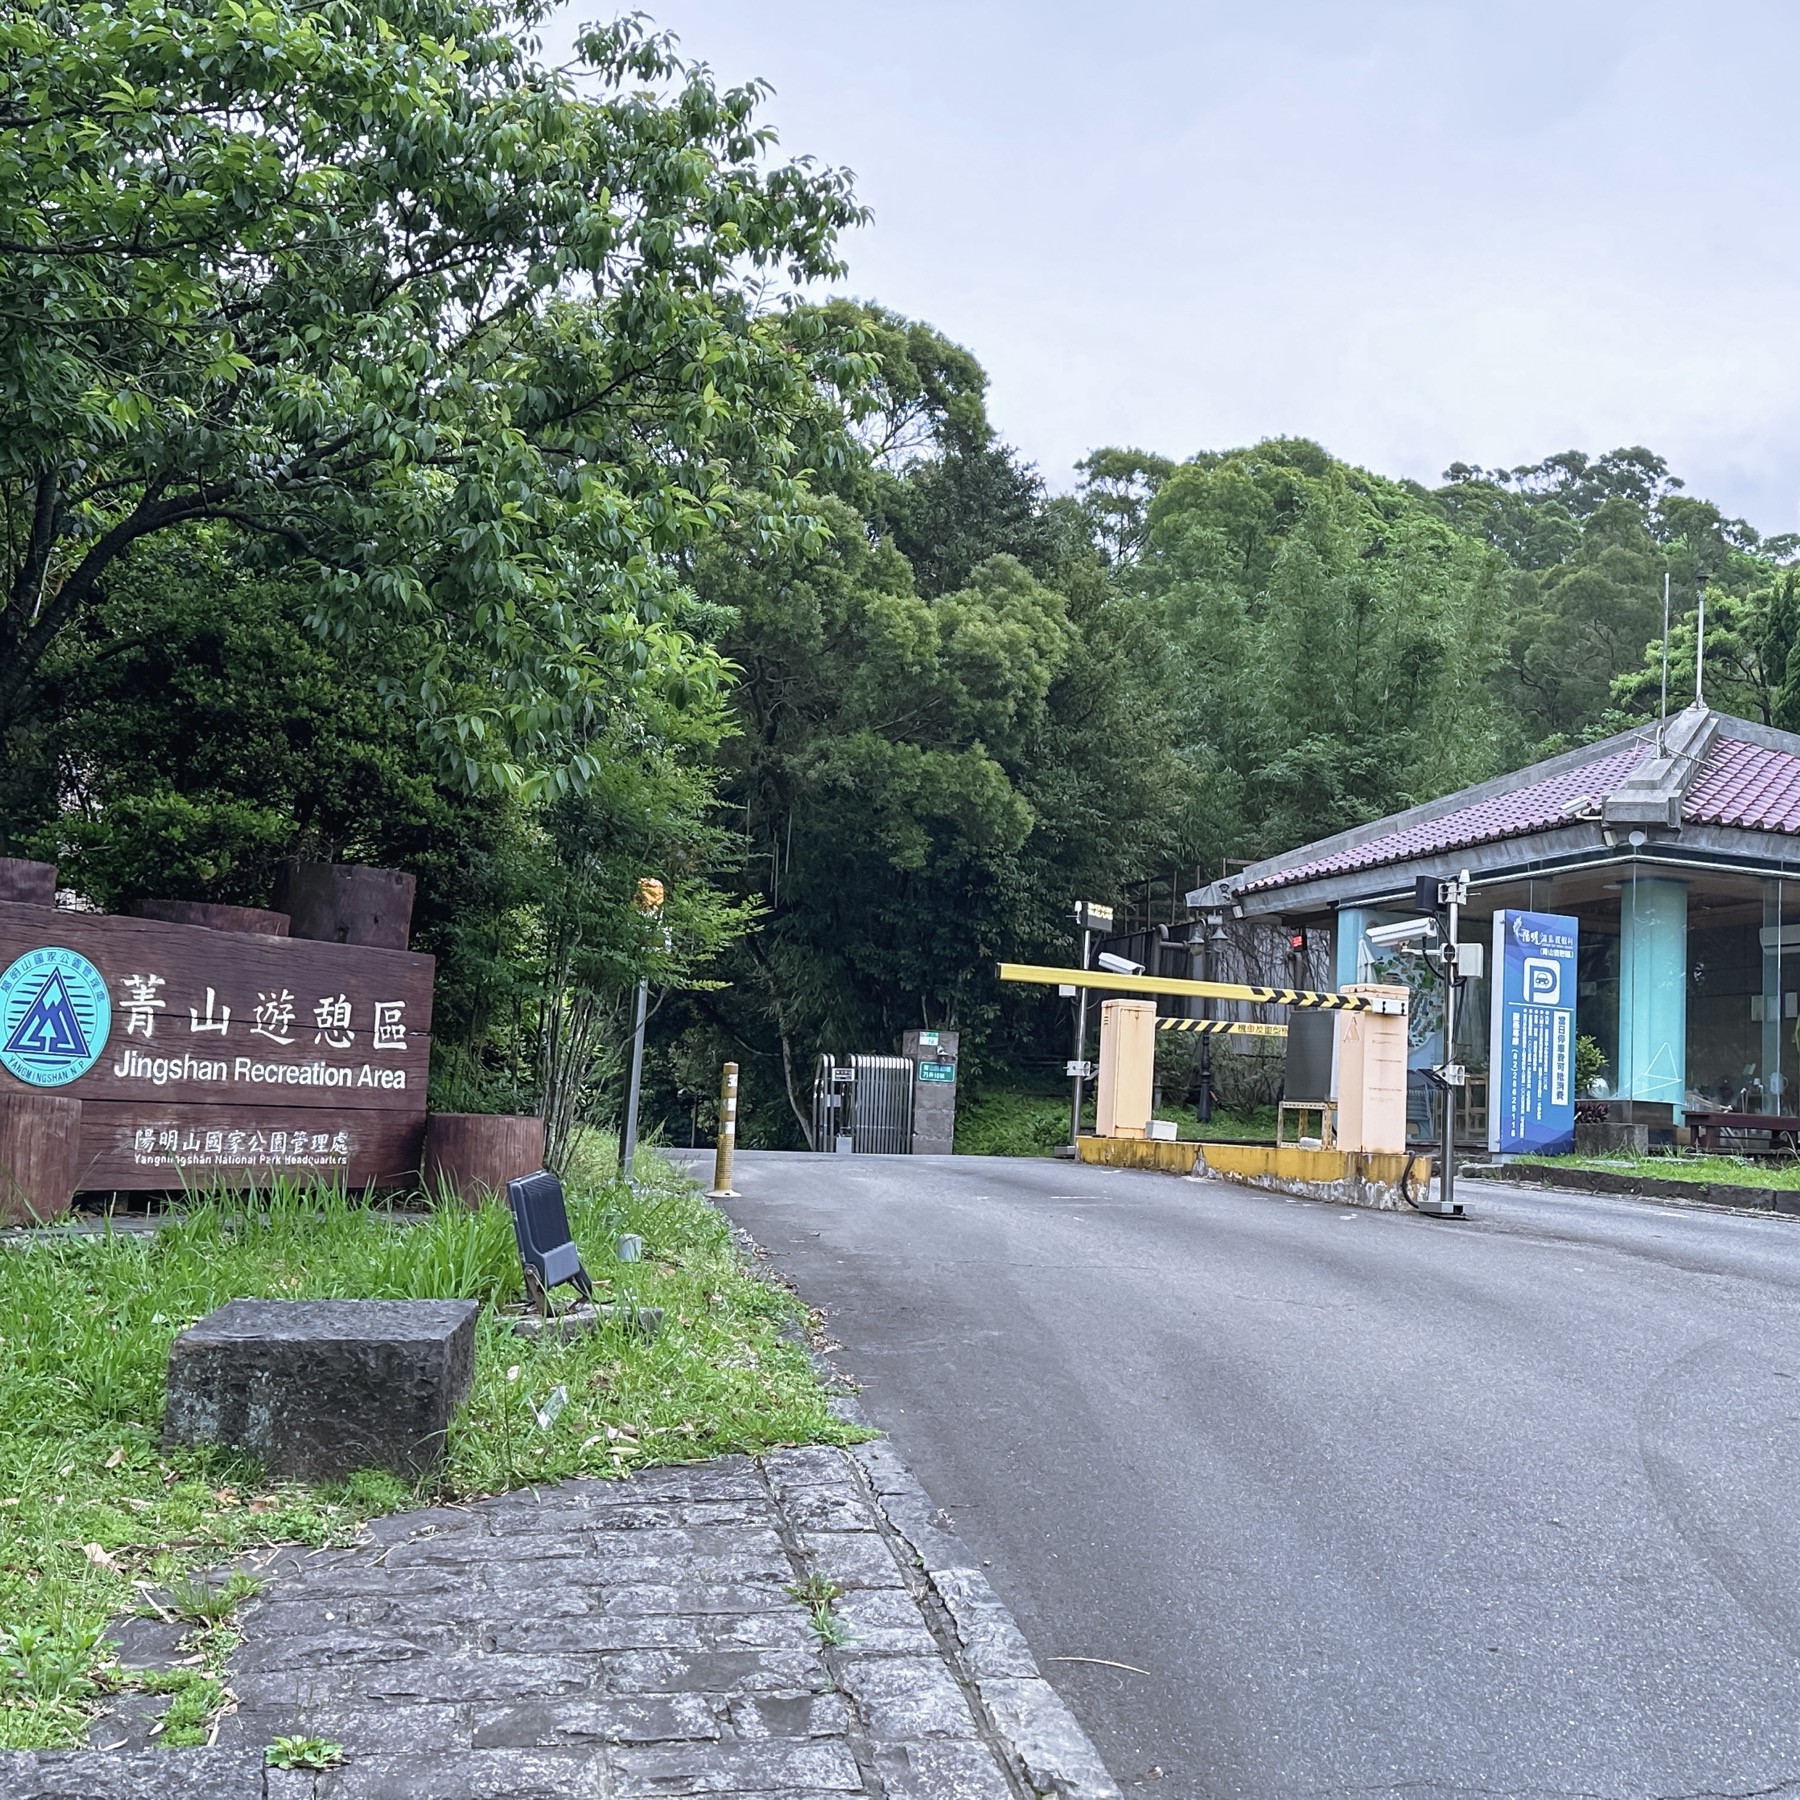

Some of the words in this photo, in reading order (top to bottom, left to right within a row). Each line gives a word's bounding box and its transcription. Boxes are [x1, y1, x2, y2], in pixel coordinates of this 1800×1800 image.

[1, 951, 106, 1003] 陽明山國家公園管理處
[119, 974, 407, 1050] 菁山遊憩區
[8, 1056, 68, 1083] YANGMINGSHAN
[114, 1050, 226, 1085] Jingshan
[234, 1057, 352, 1087] Recreation
[357, 1064, 406, 1089] Area
[134, 1128, 349, 1155] 陽明山國家公園管理處
[215, 1154, 256, 1166] National
[260, 1154, 281, 1165] Park
